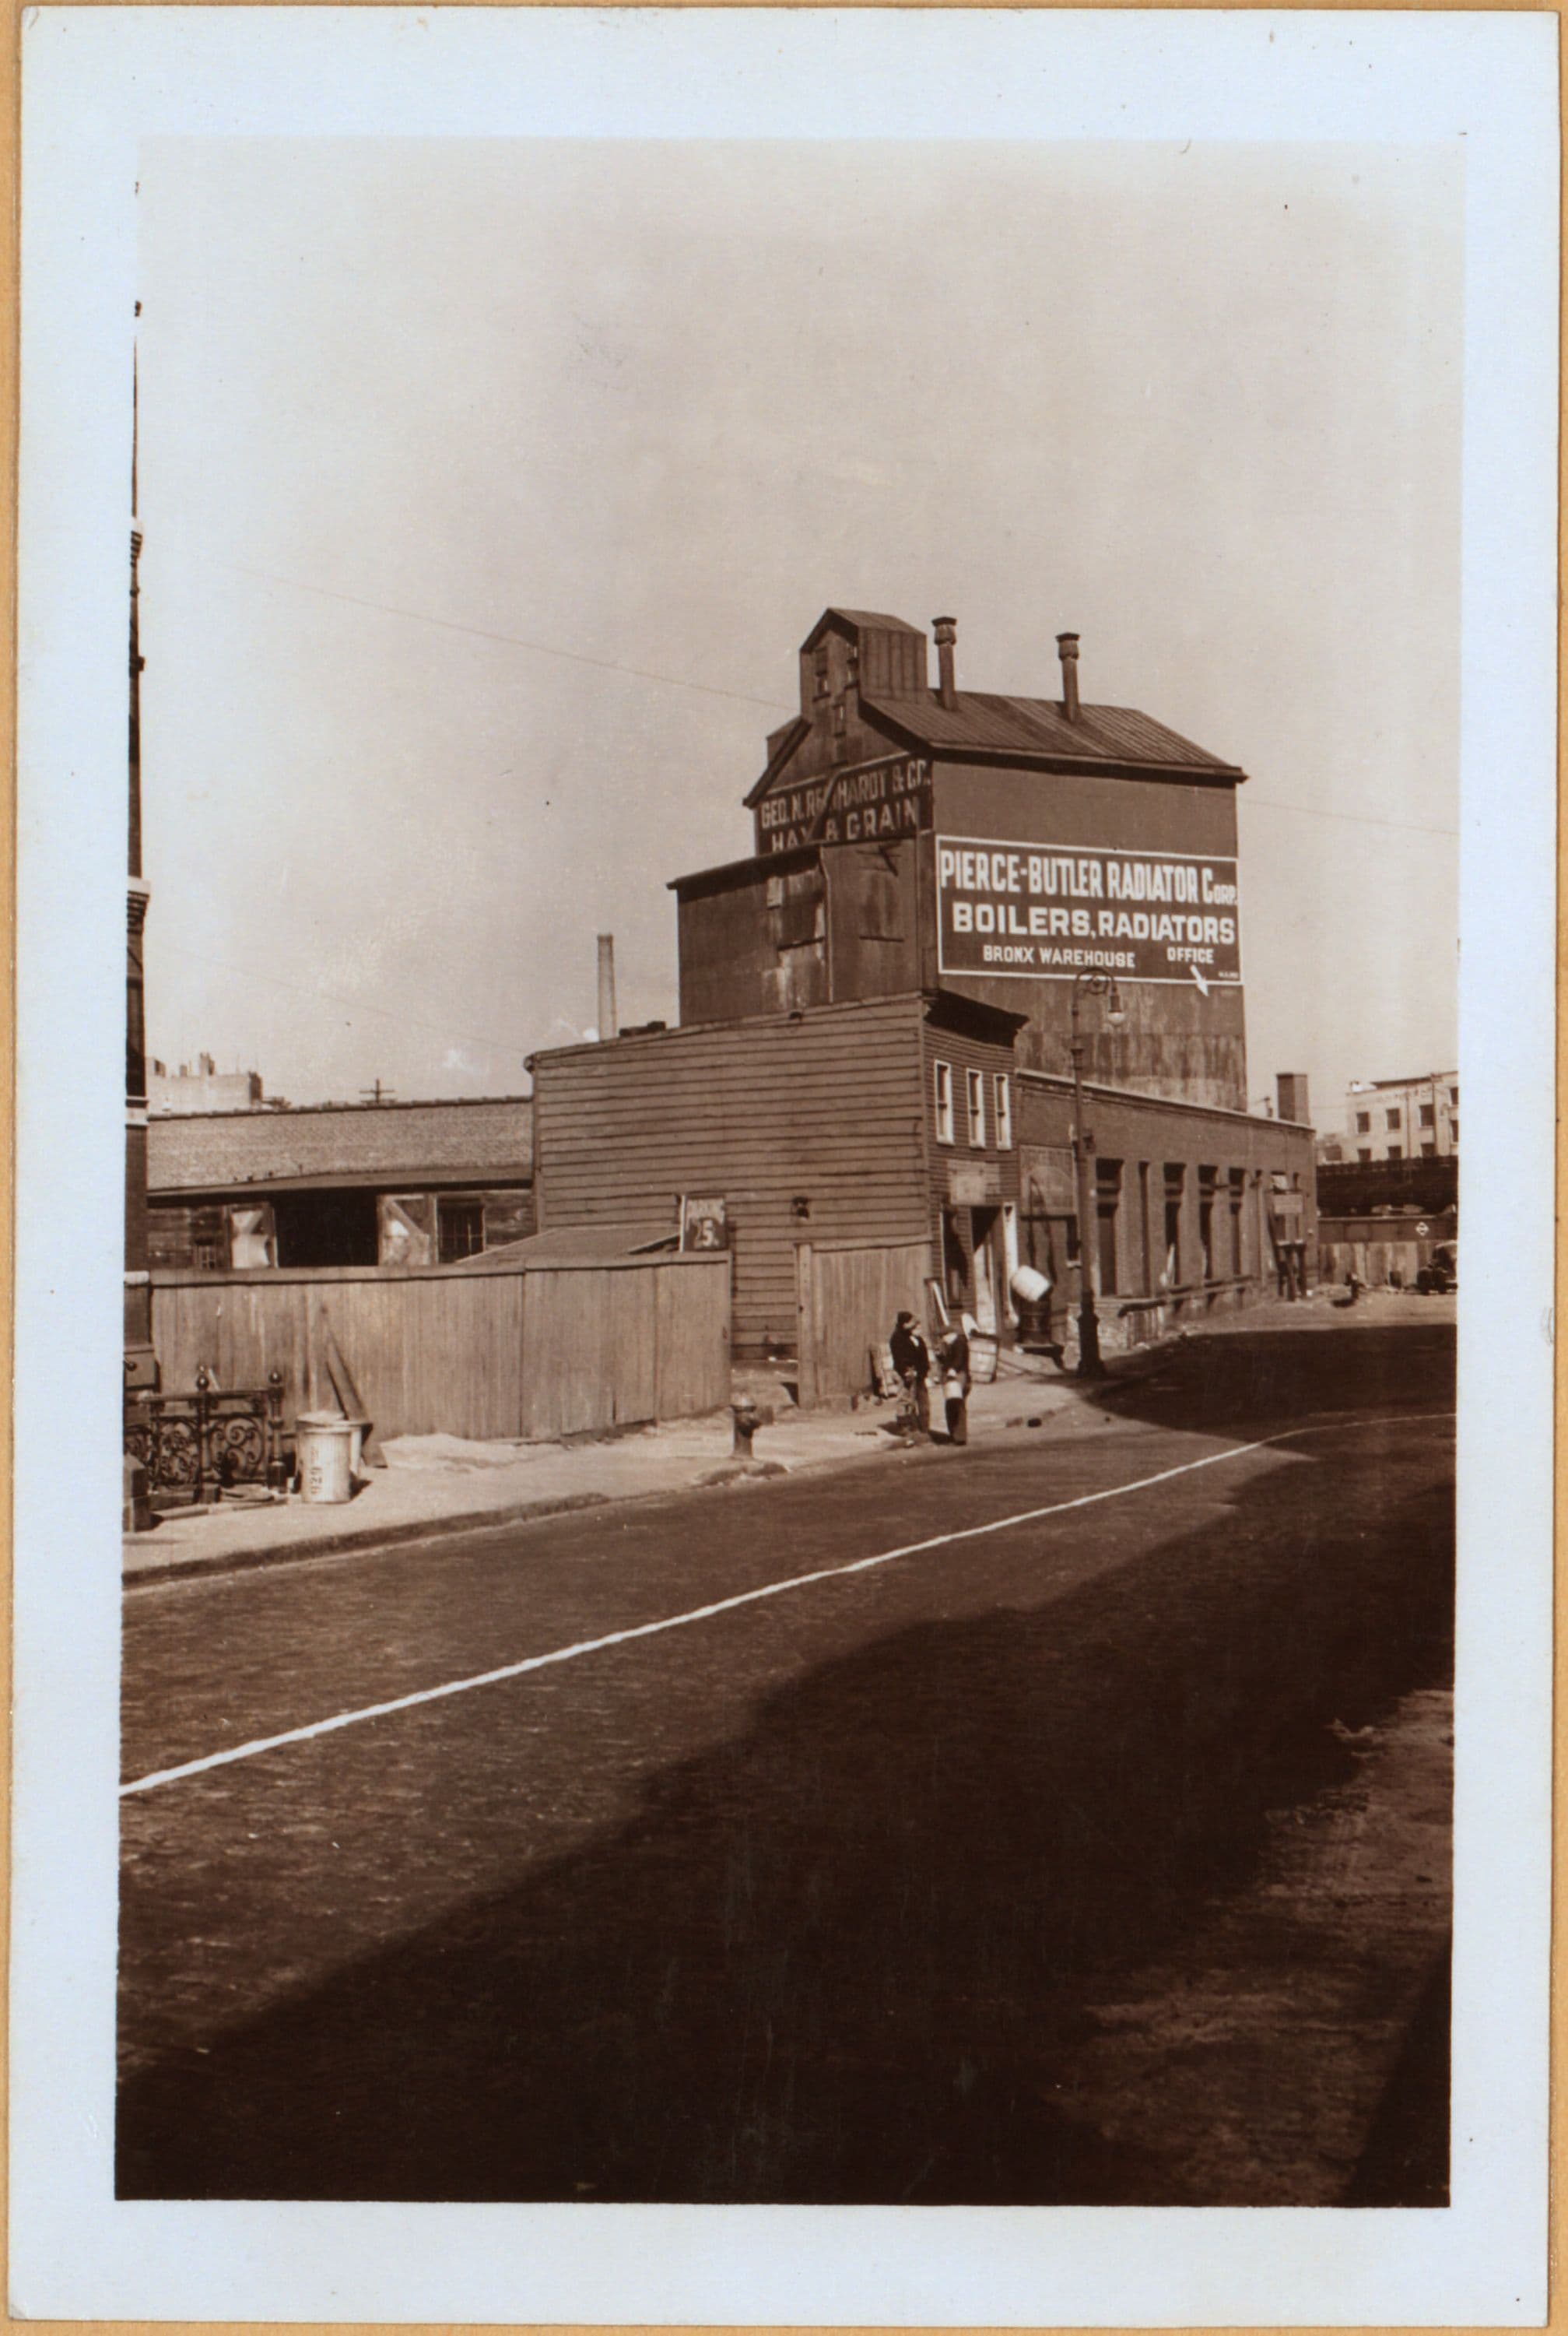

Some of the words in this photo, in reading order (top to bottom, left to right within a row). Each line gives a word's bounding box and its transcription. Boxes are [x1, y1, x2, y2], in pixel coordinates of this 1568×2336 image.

[892, 765, 904, 792] &
[846, 796, 919, 840] GRAIN
[940, 849, 1103, 898] PIERCE-BUTLER
[1107, 861, 1198, 904] RADIATOR
[983, 944, 1034, 964] BRONX
[1039, 946, 1135, 968] WAREHOUSE
[1166, 947, 1214, 964] OFFICE
